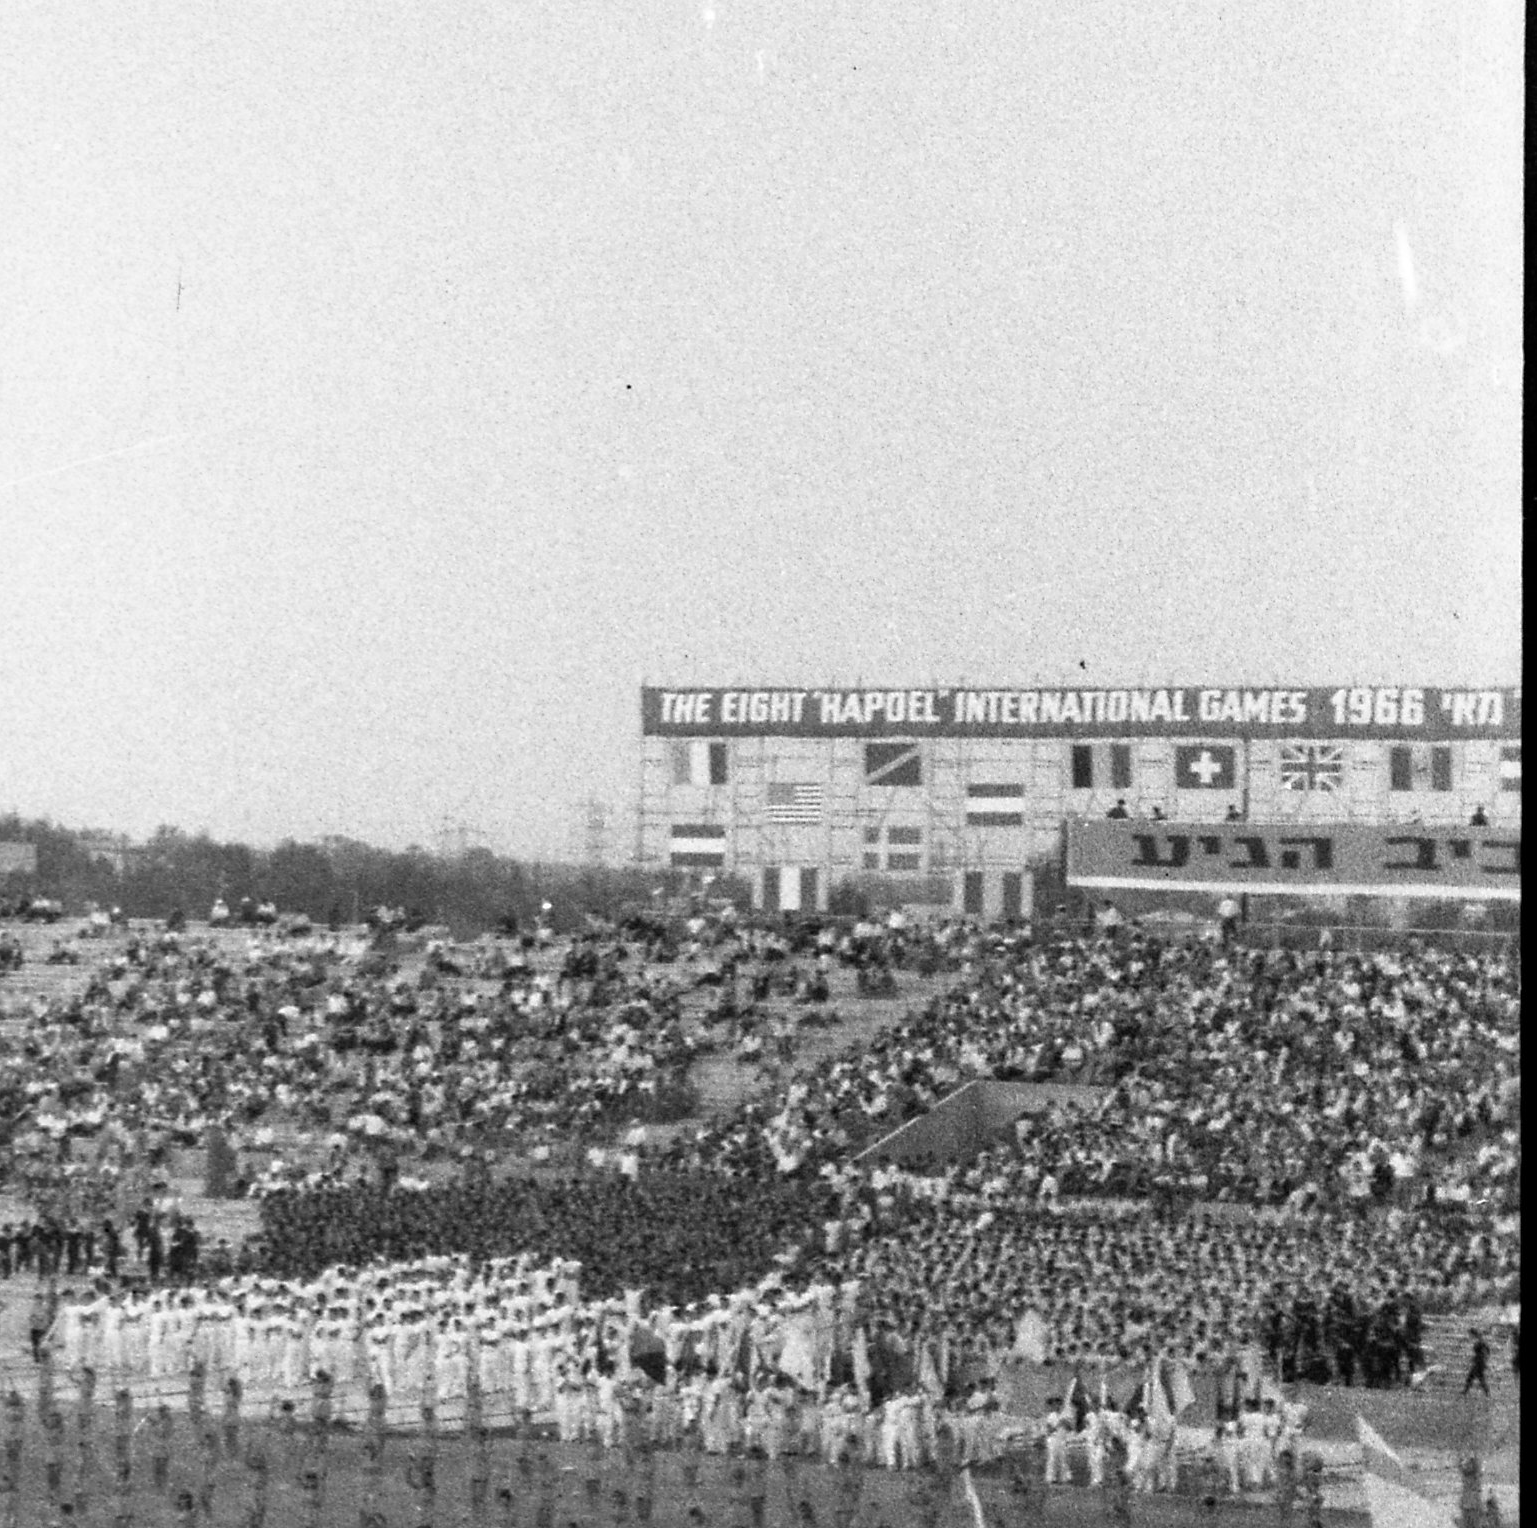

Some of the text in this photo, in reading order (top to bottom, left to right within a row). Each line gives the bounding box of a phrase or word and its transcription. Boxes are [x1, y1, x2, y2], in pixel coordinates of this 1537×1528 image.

[661, 692, 713, 723] THE
[721, 691, 807, 723] EIGHT
[954, 689, 1190, 723] INTERNATIONAL
[1198, 689, 1307, 723] GAMES
[1329, 687, 1425, 724] 1966
[1440, 691, 1504, 726] מאי
